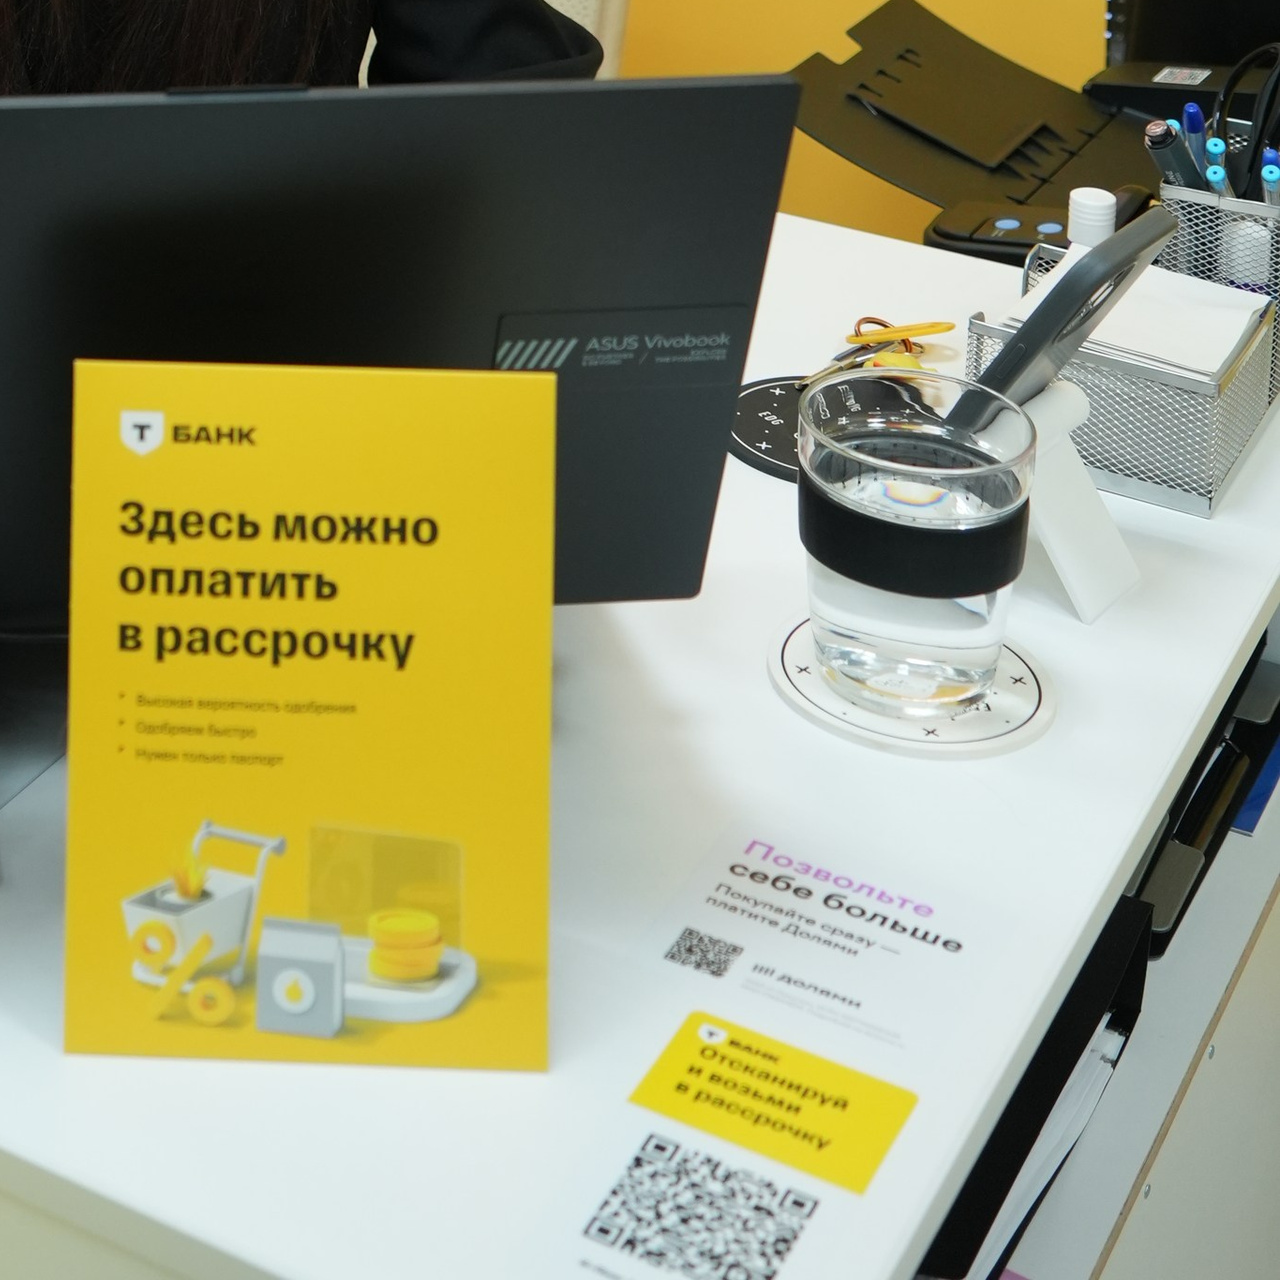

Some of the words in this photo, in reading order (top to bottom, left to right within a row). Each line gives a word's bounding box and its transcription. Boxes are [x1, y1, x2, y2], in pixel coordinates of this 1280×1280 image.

[586, 335, 640, 352] ASUS
[644, 332, 731, 349] Vivobook
[172, 424, 257, 446] БАНК
[120, 500, 261, 544] Здесь
[272, 512, 440, 546] можно
[119, 564, 339, 602] оплатить
[118, 624, 143, 652] в
[154, 623, 415, 672] рассрочку
[743, 839, 935, 918] Позвольте
[705, 896, 780, 927] платите
[781, 922, 859, 957] Долями
[715, 882, 817, 927] Покупайте
[820, 923, 877, 948] сразу
[728, 863, 814, 900] себе
[822, 892, 963, 953] больше
[777, 973, 862, 1009] долями
[687, 1064, 703, 1078] и
[708, 1072, 802, 1116] возьми
[700, 1045, 849, 1112] Отсканируй
[675, 1081, 690, 1095] в
[693, 1088, 832, 1151] рассрочку
